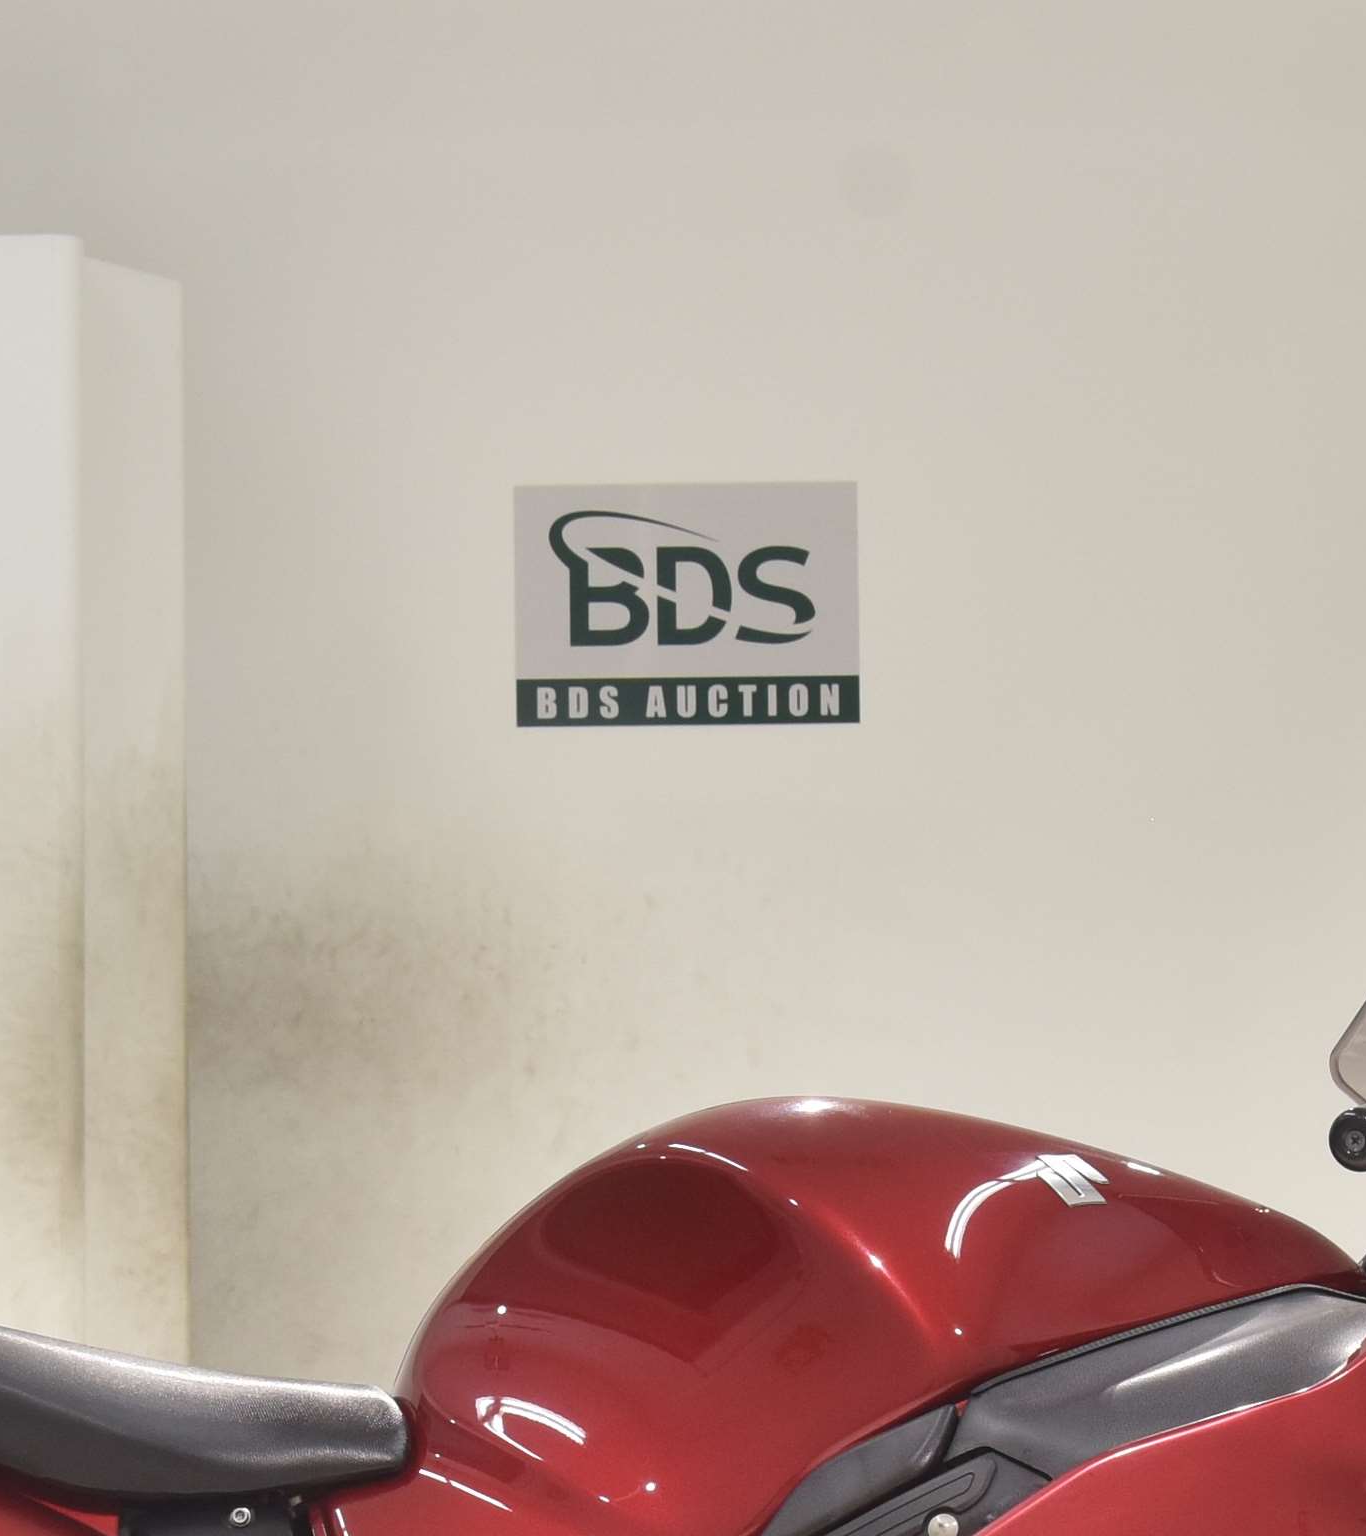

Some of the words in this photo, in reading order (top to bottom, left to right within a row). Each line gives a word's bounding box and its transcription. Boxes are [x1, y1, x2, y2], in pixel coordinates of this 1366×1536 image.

[548, 510, 816, 647] BDS
[536, 686, 620, 719] BDS
[646, 683, 841, 719] AUCTION
